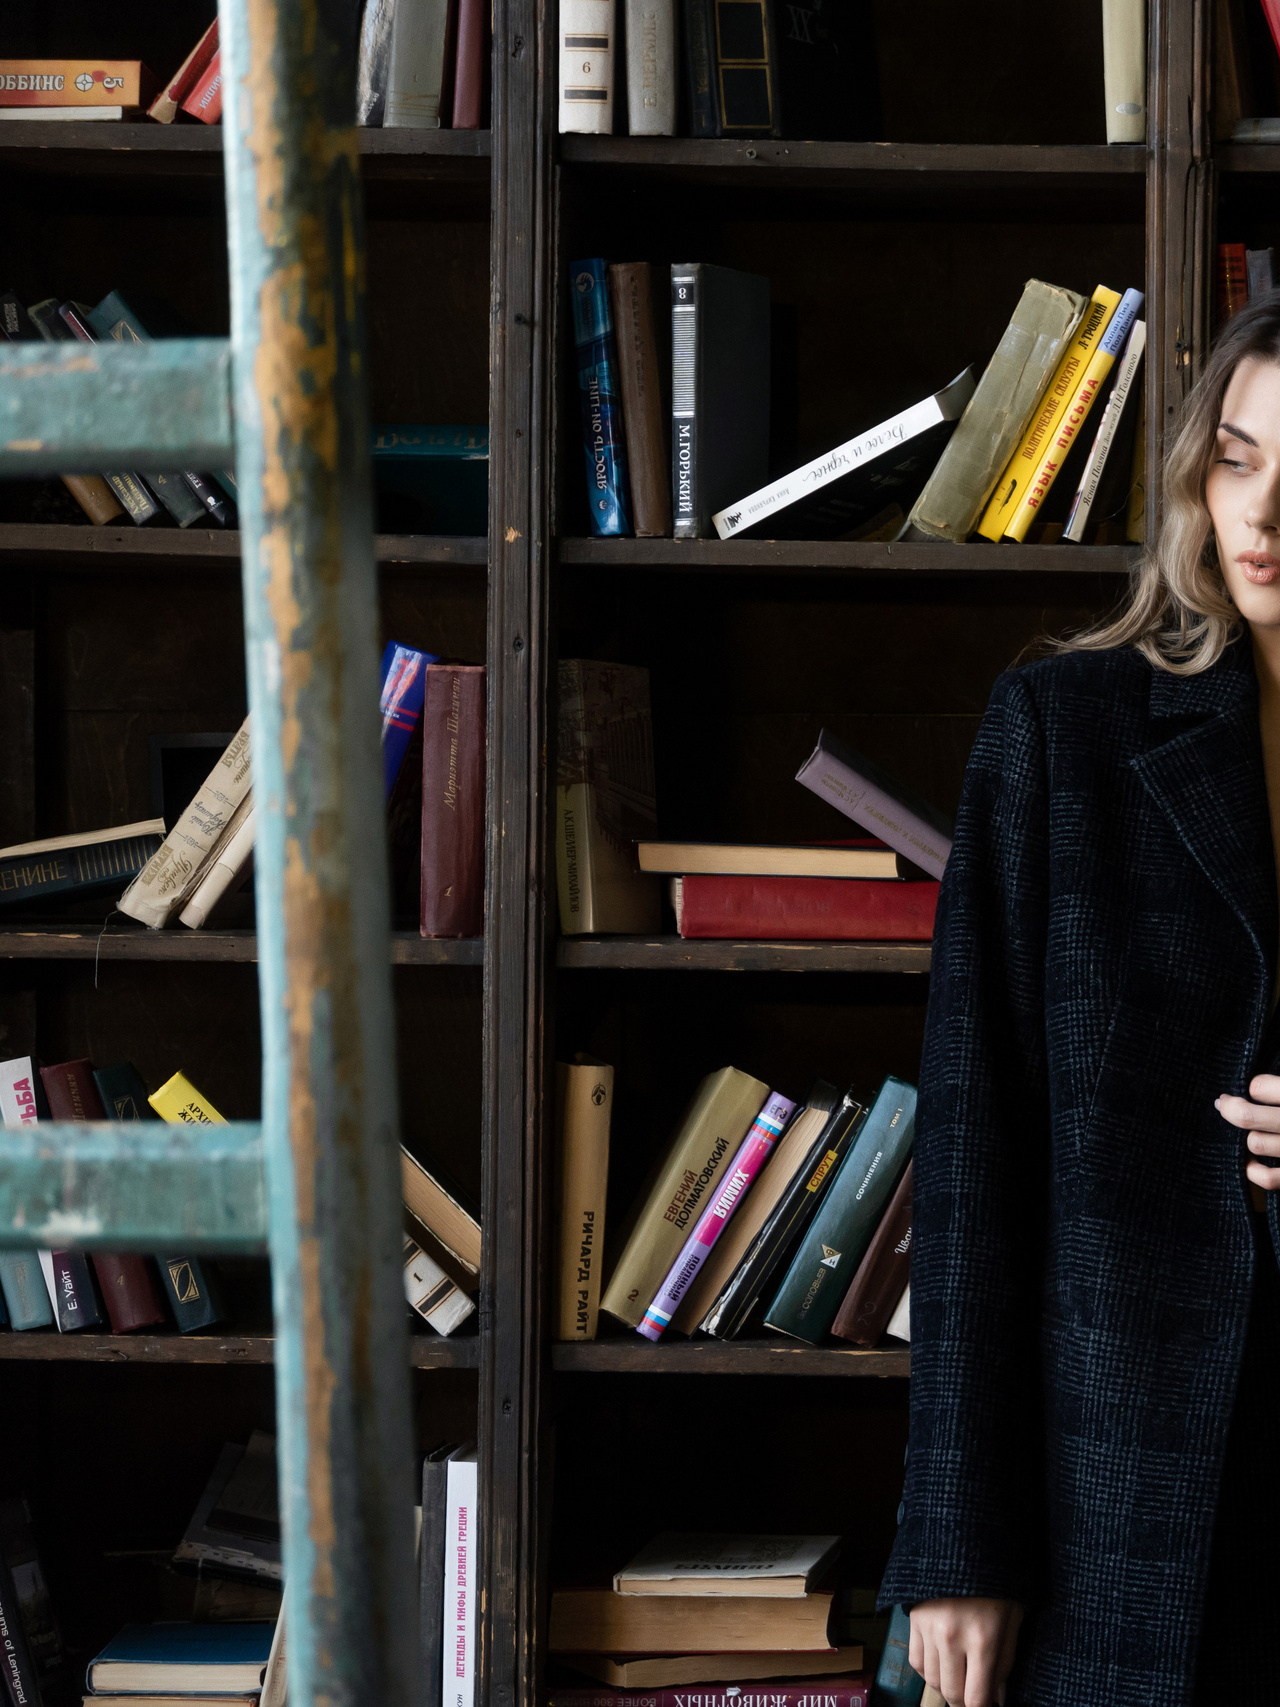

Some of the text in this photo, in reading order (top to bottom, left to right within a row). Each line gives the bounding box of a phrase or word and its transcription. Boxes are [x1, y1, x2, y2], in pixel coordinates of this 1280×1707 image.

[103, 77, 123, 89] 5
[582, 62, 591, 74] 6
[678, 288, 688, 300] 8
[1103, 302, 1130, 349] Аллан Пиз
[1022, 357, 1081, 460] ПОЛИТИЧЕСКИЕ СИЛУЭТЫ
[589, 376, 607, 490] ЯРОСТЬ ON-LINE
[865, 422, 908, 449] Белое
[1027, 378, 1099, 509] ЯЗЫК ПИСЬМА
[801, 452, 851, 482] черное
[1083, 480, 1097, 507] Ясная
[1090, 446, 1108, 480] Поляна
[111, 475, 141, 515] Александр
[443, 677, 462, 812] Мариэтта Шагинян
[769, 1104, 788, 1118] ЕГЭ
[889, 1114, 900, 1128] ТОМ
[674, 1136, 730, 1231] ДОЛМАТОВСКИЙ
[712, 1168, 750, 1220] ХИМИЯ
[811, 1153, 834, 1188] СПРУТ
[855, 1151, 882, 1200] СОЧИНЕНИЯ
[662, 1168, 699, 1224] ЕВГЕНИЙ
[61, 1269, 78, 1311] Е. Уайт
[576, 1210, 595, 1334] РИЧАРД РАЙТ
[670, 1255, 700, 1302] ПОЛНЫЙ
[802, 1268, 826, 1310] СОЛОВЬЕВ
[456, 1506, 468, 1679] ЛЕГЕНДЫ И МИФЫ ДРЕВНЕЙ ГРЕЦИИ
[5, 1639, 28, 1704] of Leningrad
[673, 1694, 839, 1707] МИР ЖИВОТНЫХ
